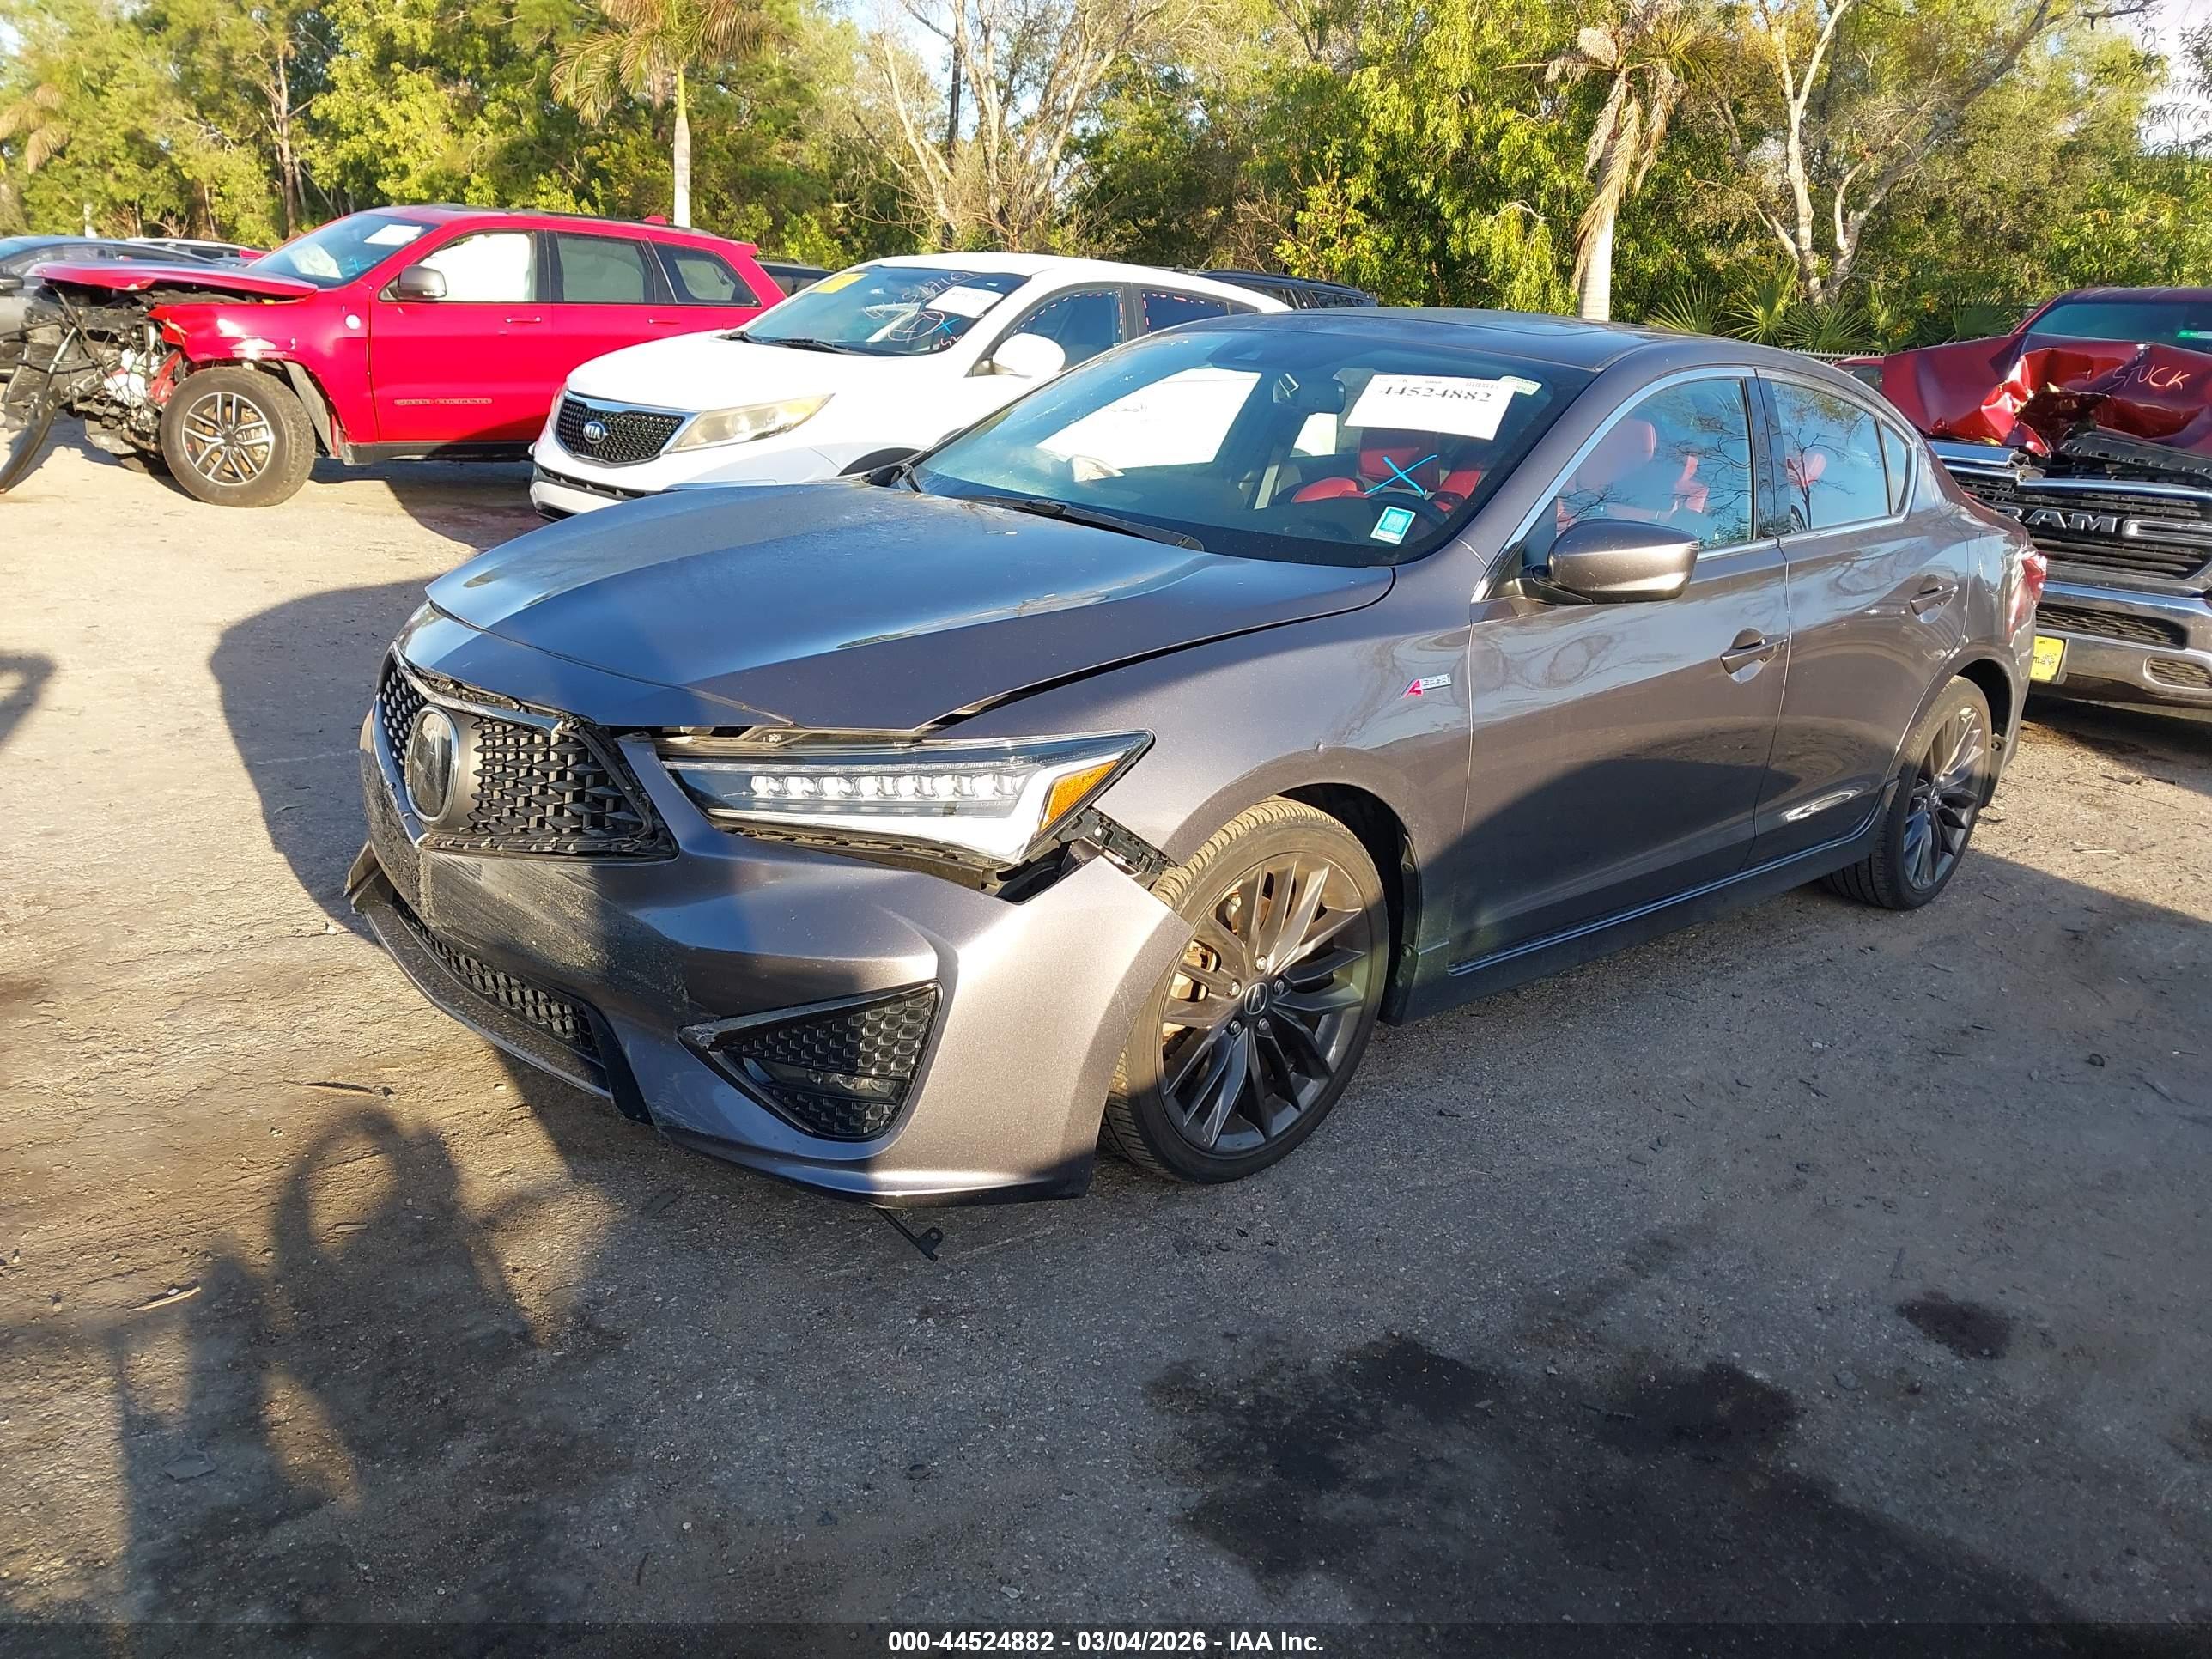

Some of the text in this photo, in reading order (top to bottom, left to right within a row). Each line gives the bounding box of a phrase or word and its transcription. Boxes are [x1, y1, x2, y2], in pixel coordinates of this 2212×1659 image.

[2101, 364, 2191, 391] STUCK
[1379, 386, 1492, 402] 44524882
[585, 425, 600, 440] KIA
[1996, 505, 2118, 534] RAM
